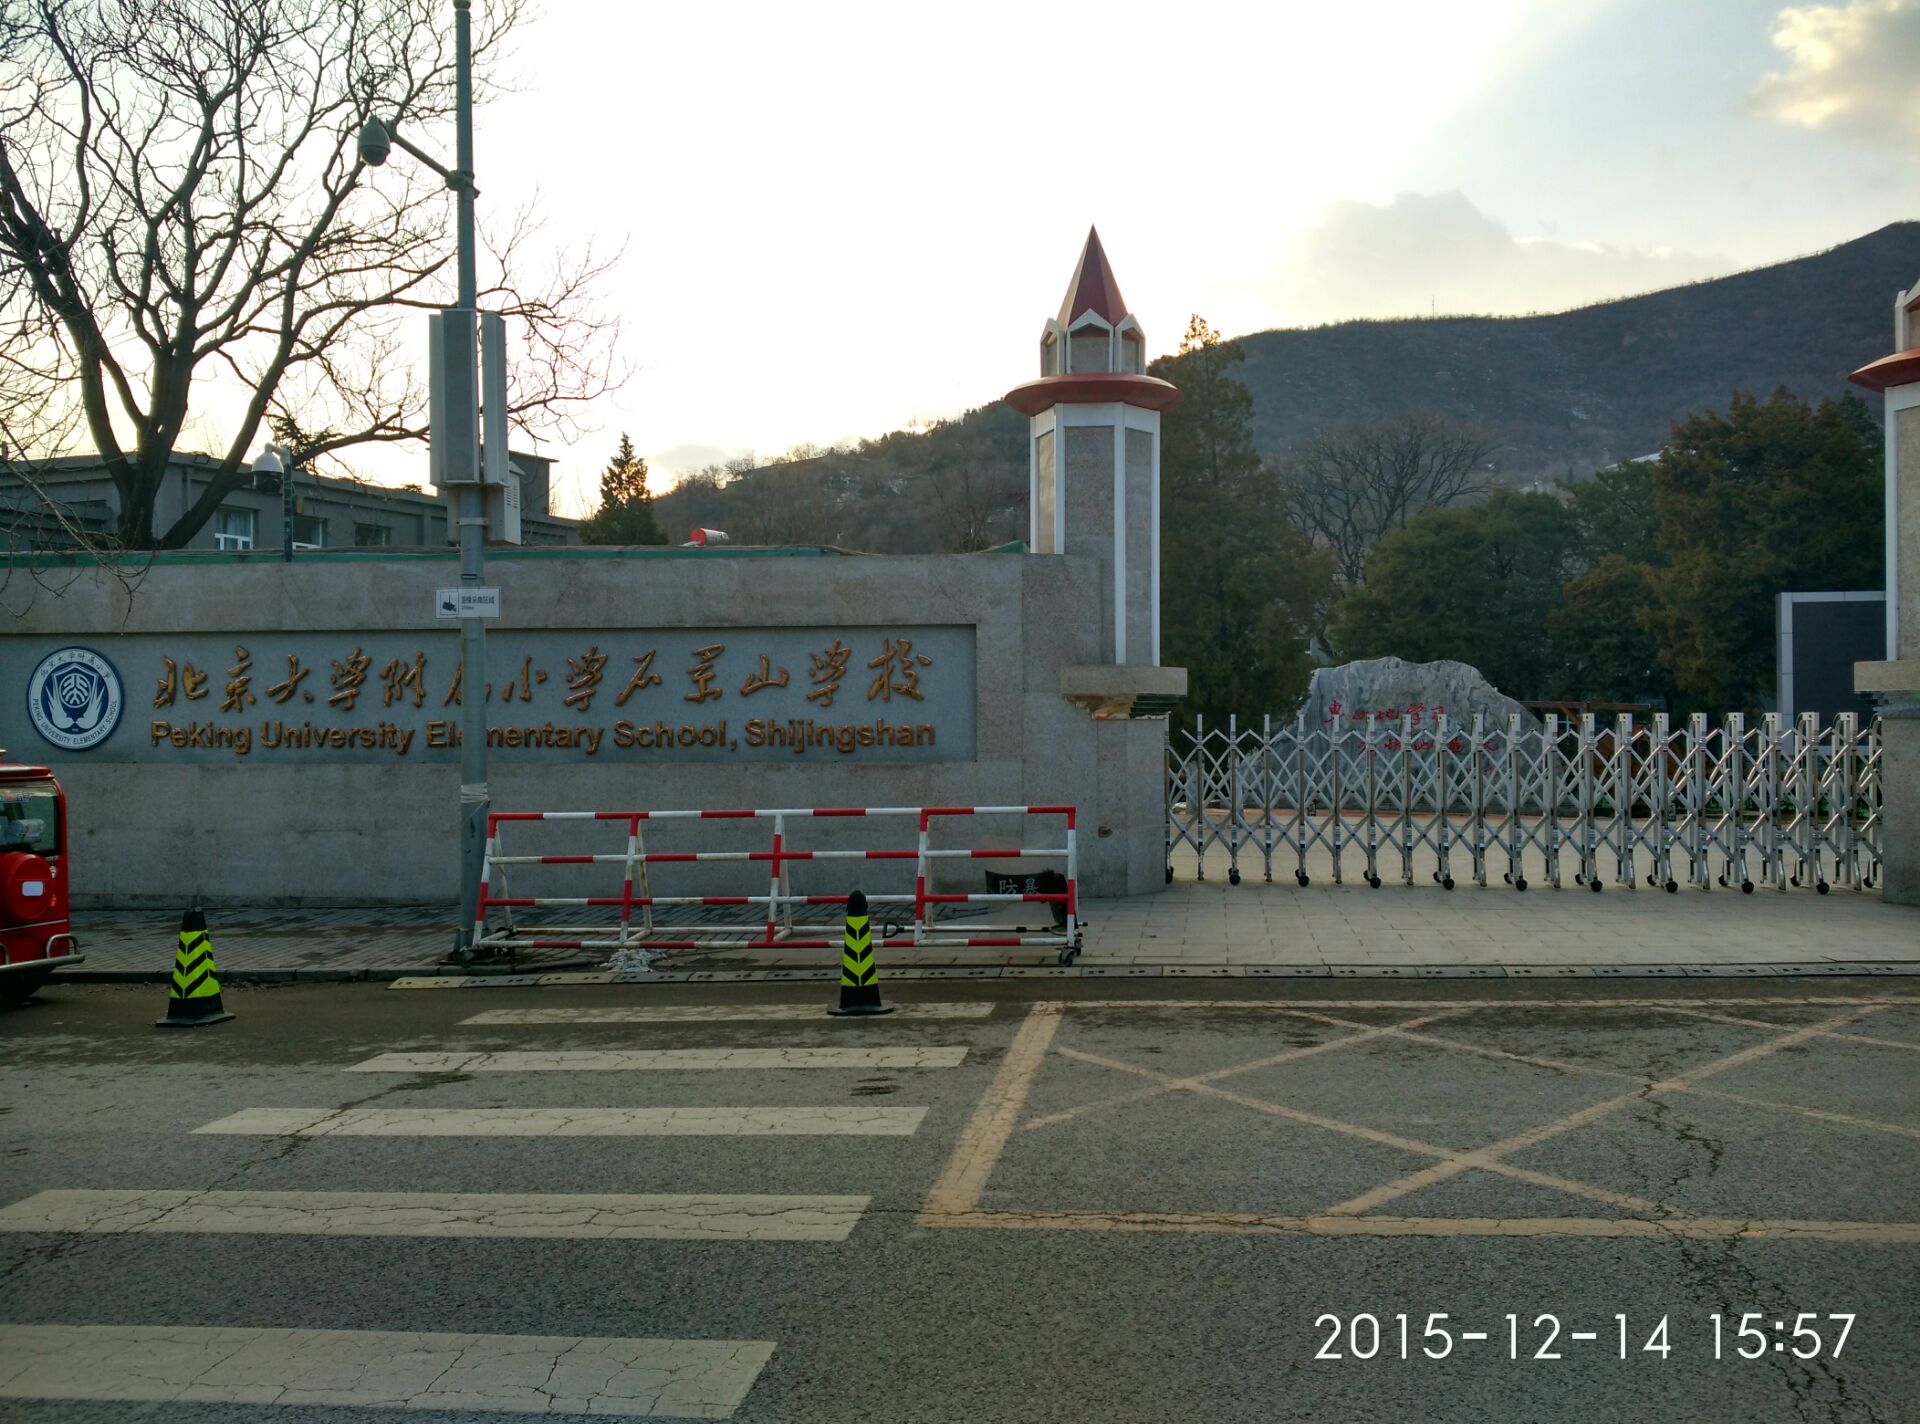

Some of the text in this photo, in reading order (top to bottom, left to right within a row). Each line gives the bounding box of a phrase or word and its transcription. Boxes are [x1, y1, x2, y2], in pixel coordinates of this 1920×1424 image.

[152, 638, 933, 712] 北京大学附小学石景山学校
[41, 721, 70, 744] UNIVERSITY
[73, 724, 107, 745] ELEMENTARY
[105, 700, 118, 724] SCHOOL
[151, 717, 936, 755] Peking University Elmentary School, Shijingshan
